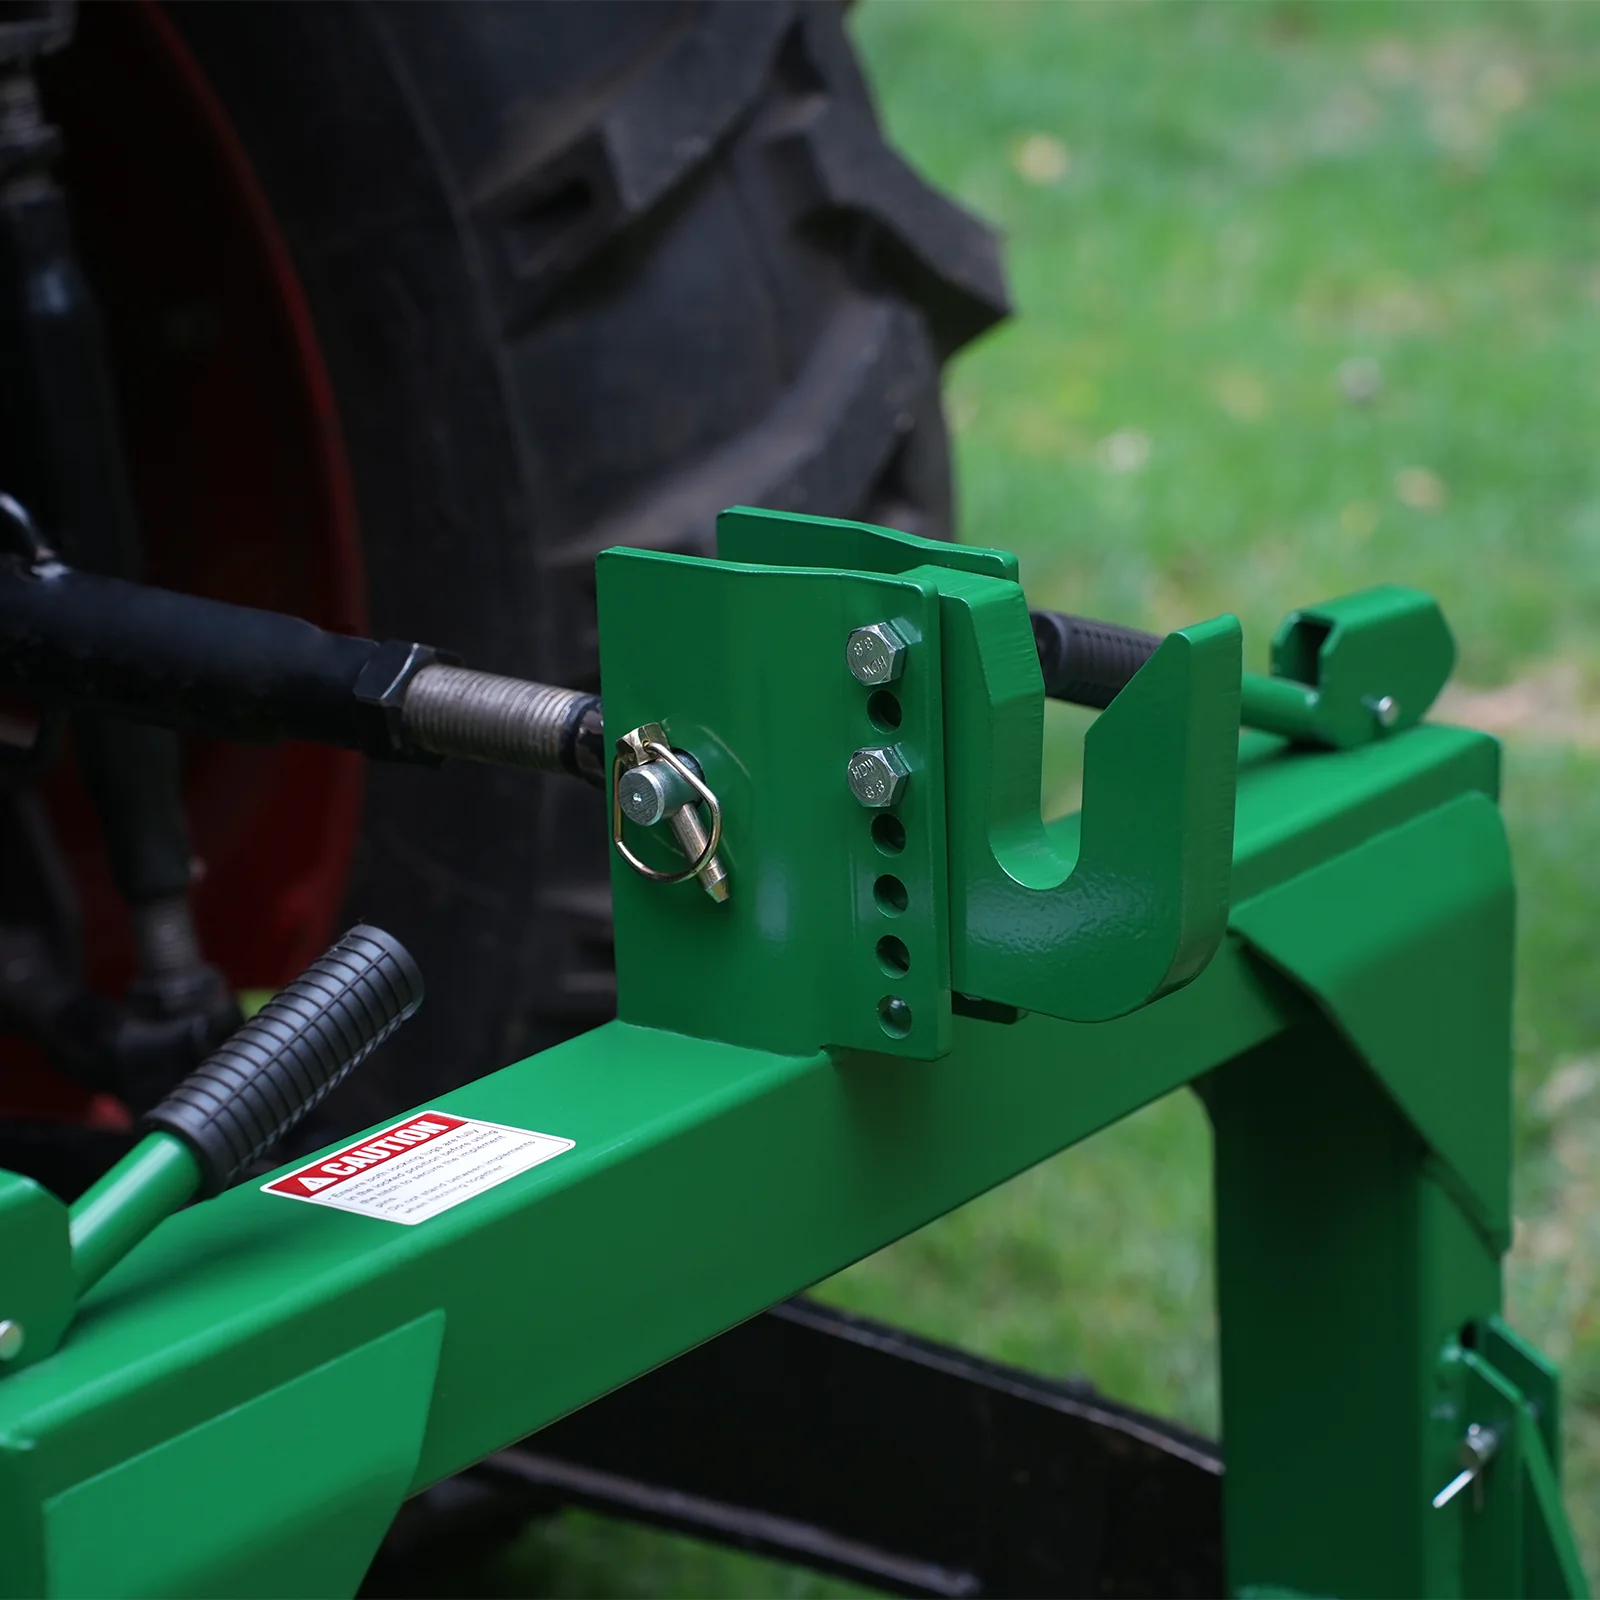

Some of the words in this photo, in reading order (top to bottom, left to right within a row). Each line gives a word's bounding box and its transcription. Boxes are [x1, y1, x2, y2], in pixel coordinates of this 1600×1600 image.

[320, 1120, 449, 1176] CAUTION
[331, 1180, 367, 1199] Ensure
[364, 1171, 389, 1183] both
[386, 1155, 425, 1172] locking
[419, 1145, 443, 1157] lugs
[441, 1138, 459, 1147] are
[455, 1128, 480, 1140] fully
[353, 1187, 373, 1197] the
[372, 1172, 406, 1189] locked
[404, 1155, 442, 1174] position
[440, 1142, 472, 1157] before
[470, 1129, 499, 1143] using
[358, 1196, 378, 1205] the
[375, 1184, 401, 1197] hitch
[411, 1164, 444, 1180] secure
[441, 1157, 460, 1166] the
[457, 1134, 506, 1158] implement
[403, 1195, 420, 1205] not
[419, 1182, 447, 1196] stand
[446, 1164, 485, 1184] between
[484, 1140, 536, 1165] implements
